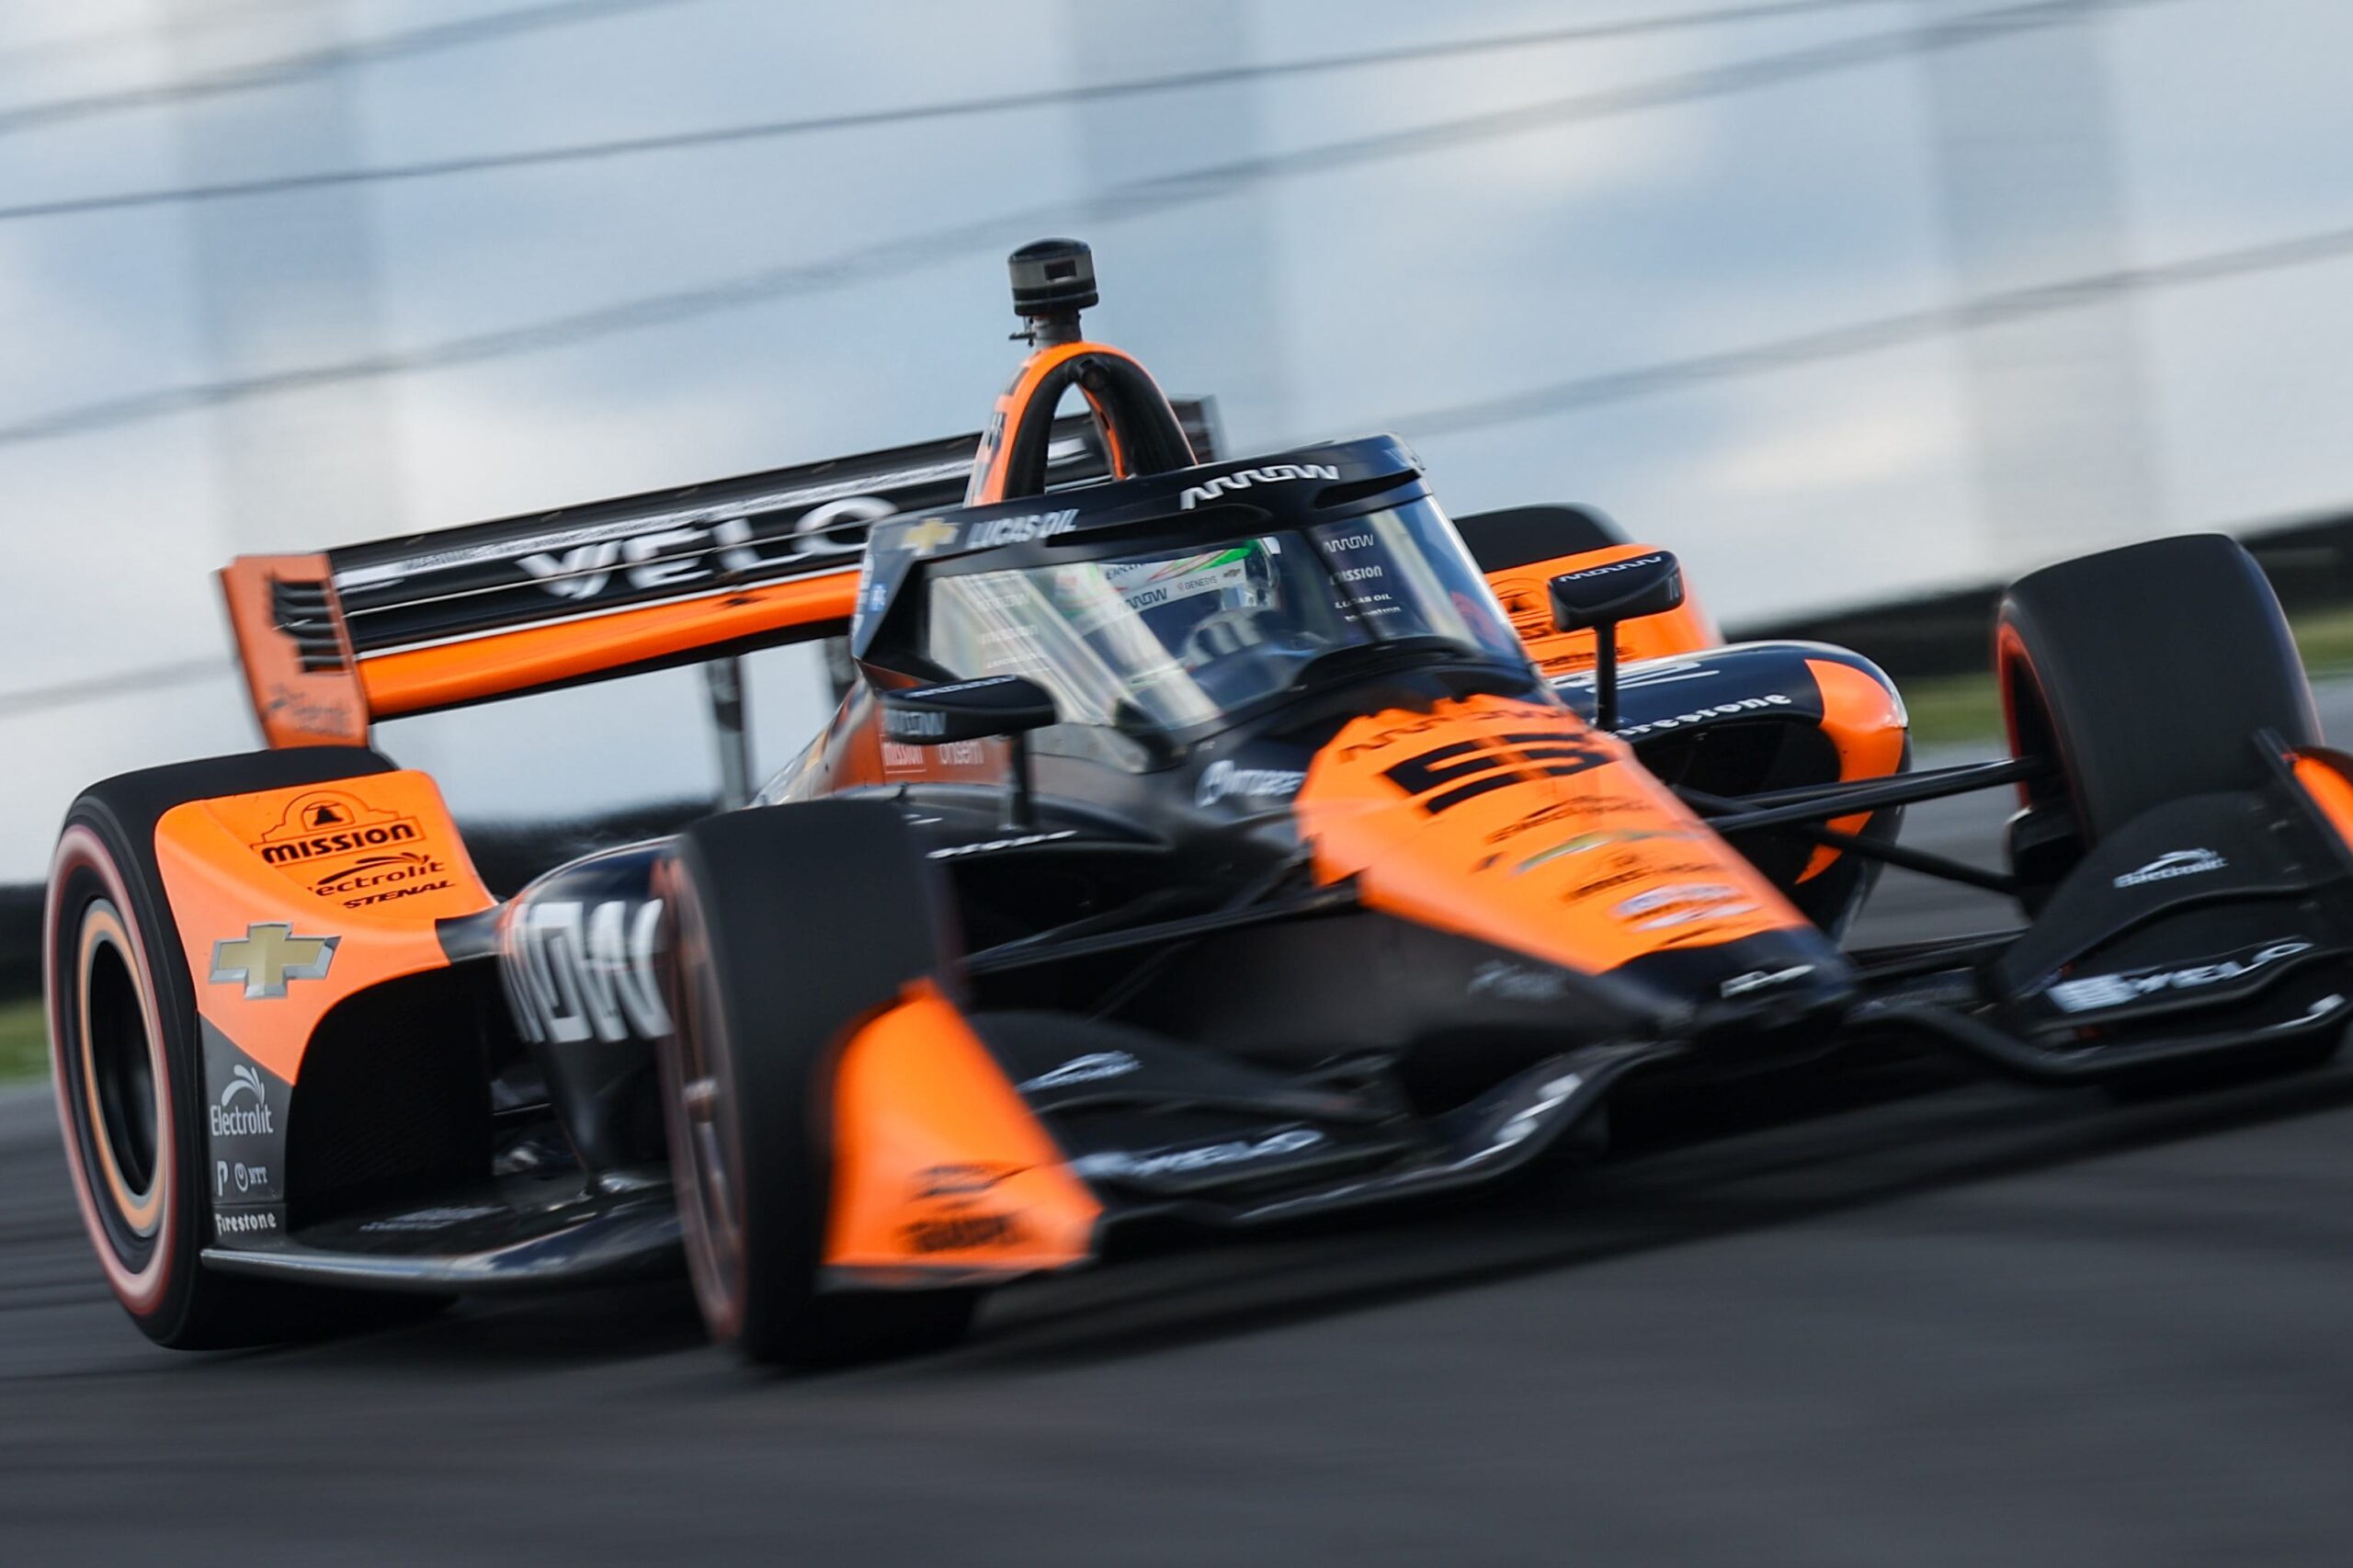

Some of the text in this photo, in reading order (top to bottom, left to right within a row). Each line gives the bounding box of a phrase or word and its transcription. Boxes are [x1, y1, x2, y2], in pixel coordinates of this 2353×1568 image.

[517, 496, 899, 599] VELO
[1335, 597, 1373, 608] LUAS
[1606, 693, 1792, 739] irestone
[306, 861, 445, 897] ectrolit
[210, 1103, 274, 1137] Electrolit
[247, 1165, 268, 1186] NTT
[213, 1210, 277, 1237] Firestone
